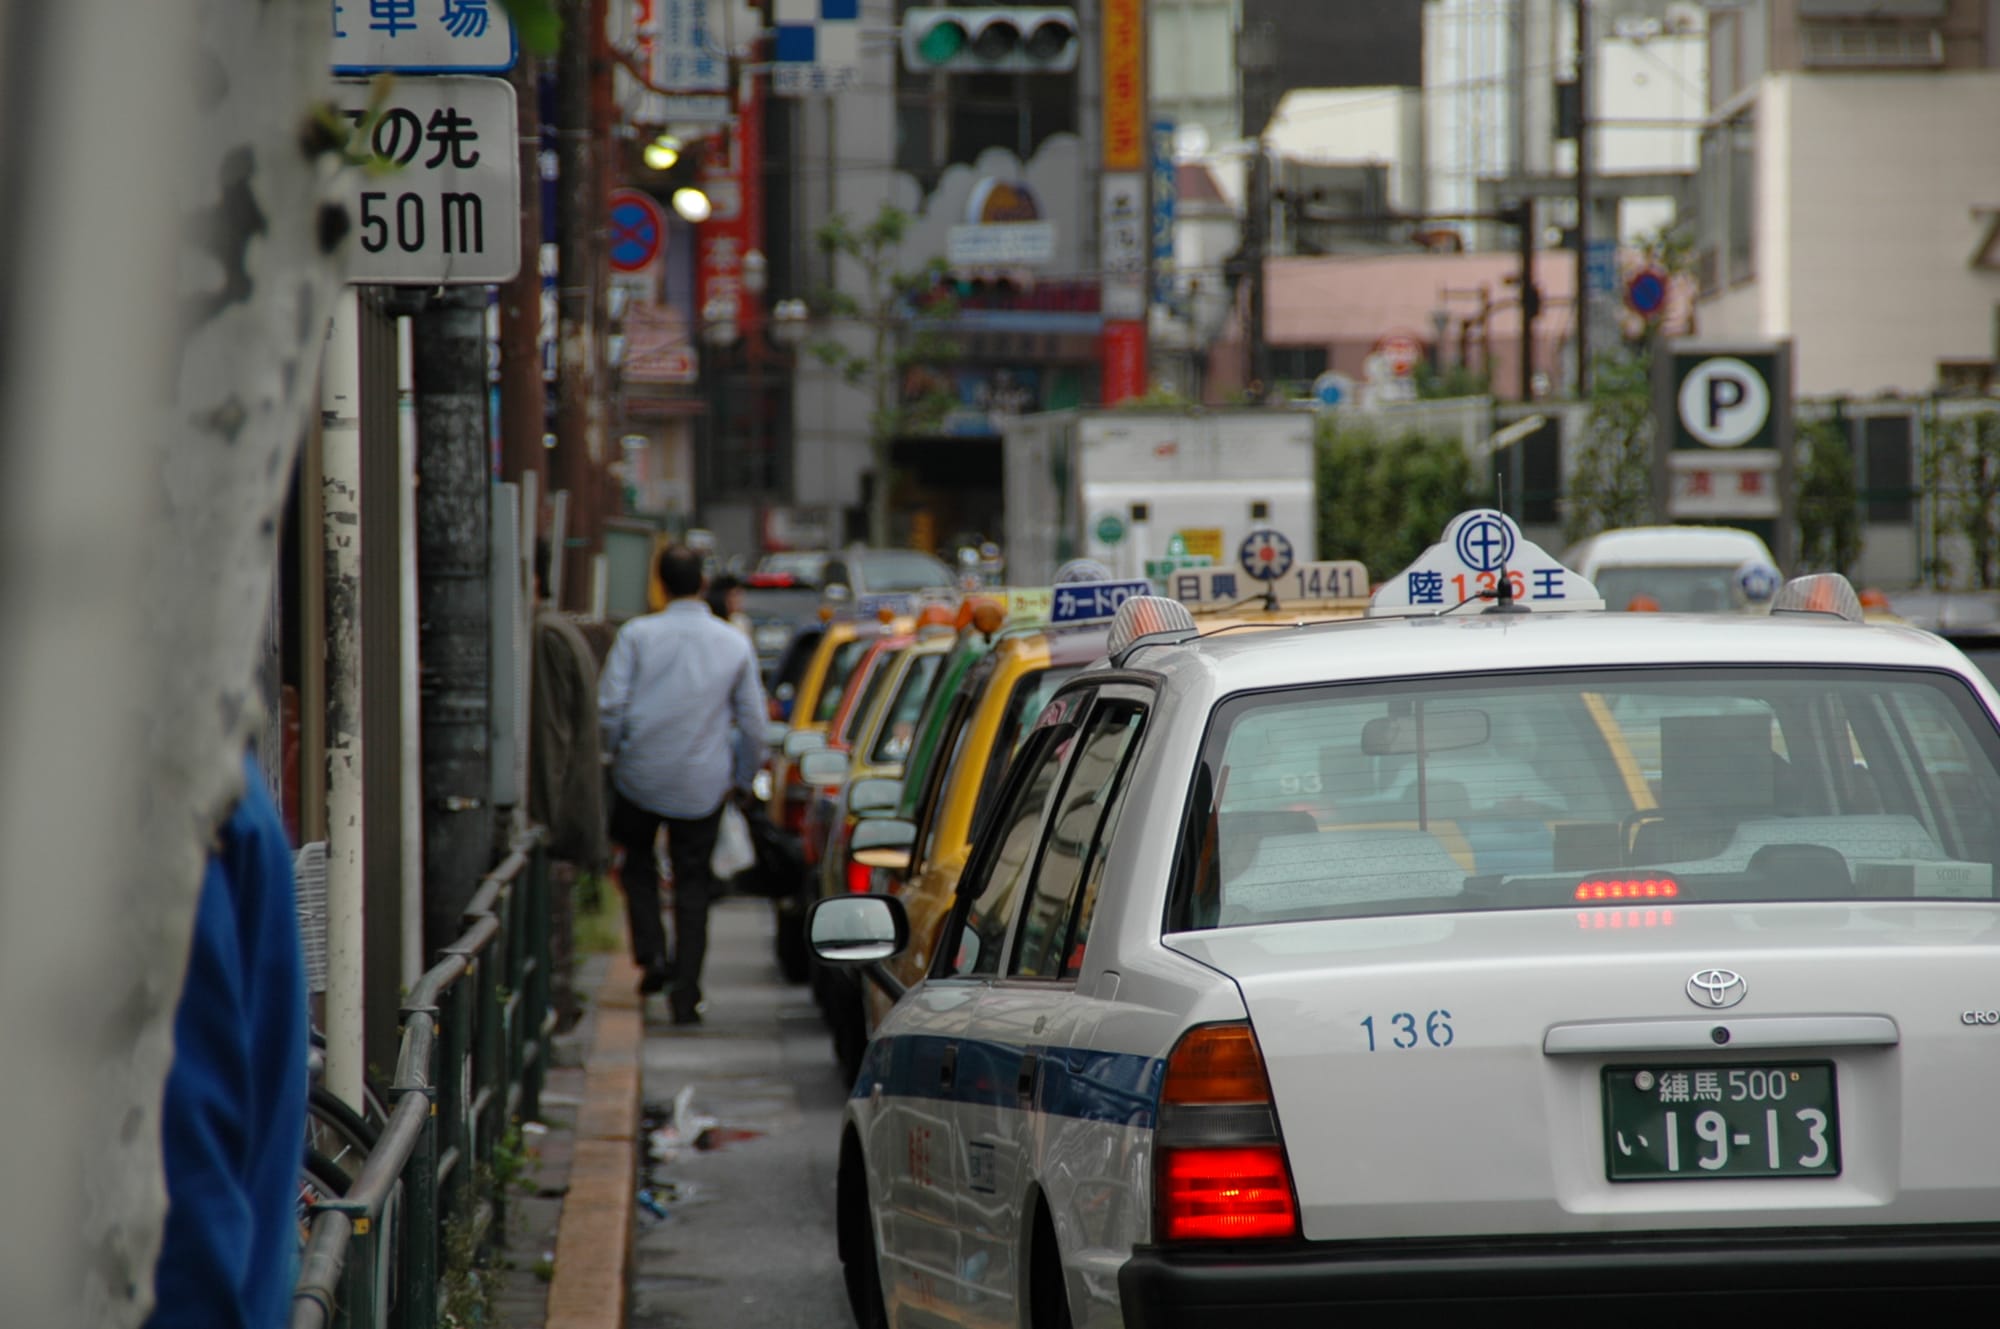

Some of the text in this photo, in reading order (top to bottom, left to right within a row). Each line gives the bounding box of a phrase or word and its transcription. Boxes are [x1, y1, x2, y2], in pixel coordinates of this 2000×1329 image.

[336, 0, 489, 37] 車場
[1708, 378, 1746, 428] P
[1296, 568, 1354, 599] 1441
[1532, 568, 1566, 599] 王
[1280, 771, 1322, 795] 93
[1360, 1009, 1454, 1051] 136
[1659, 1070, 1787, 1102] 練馬 500
[1617, 1108, 1828, 1171] い 19-13
